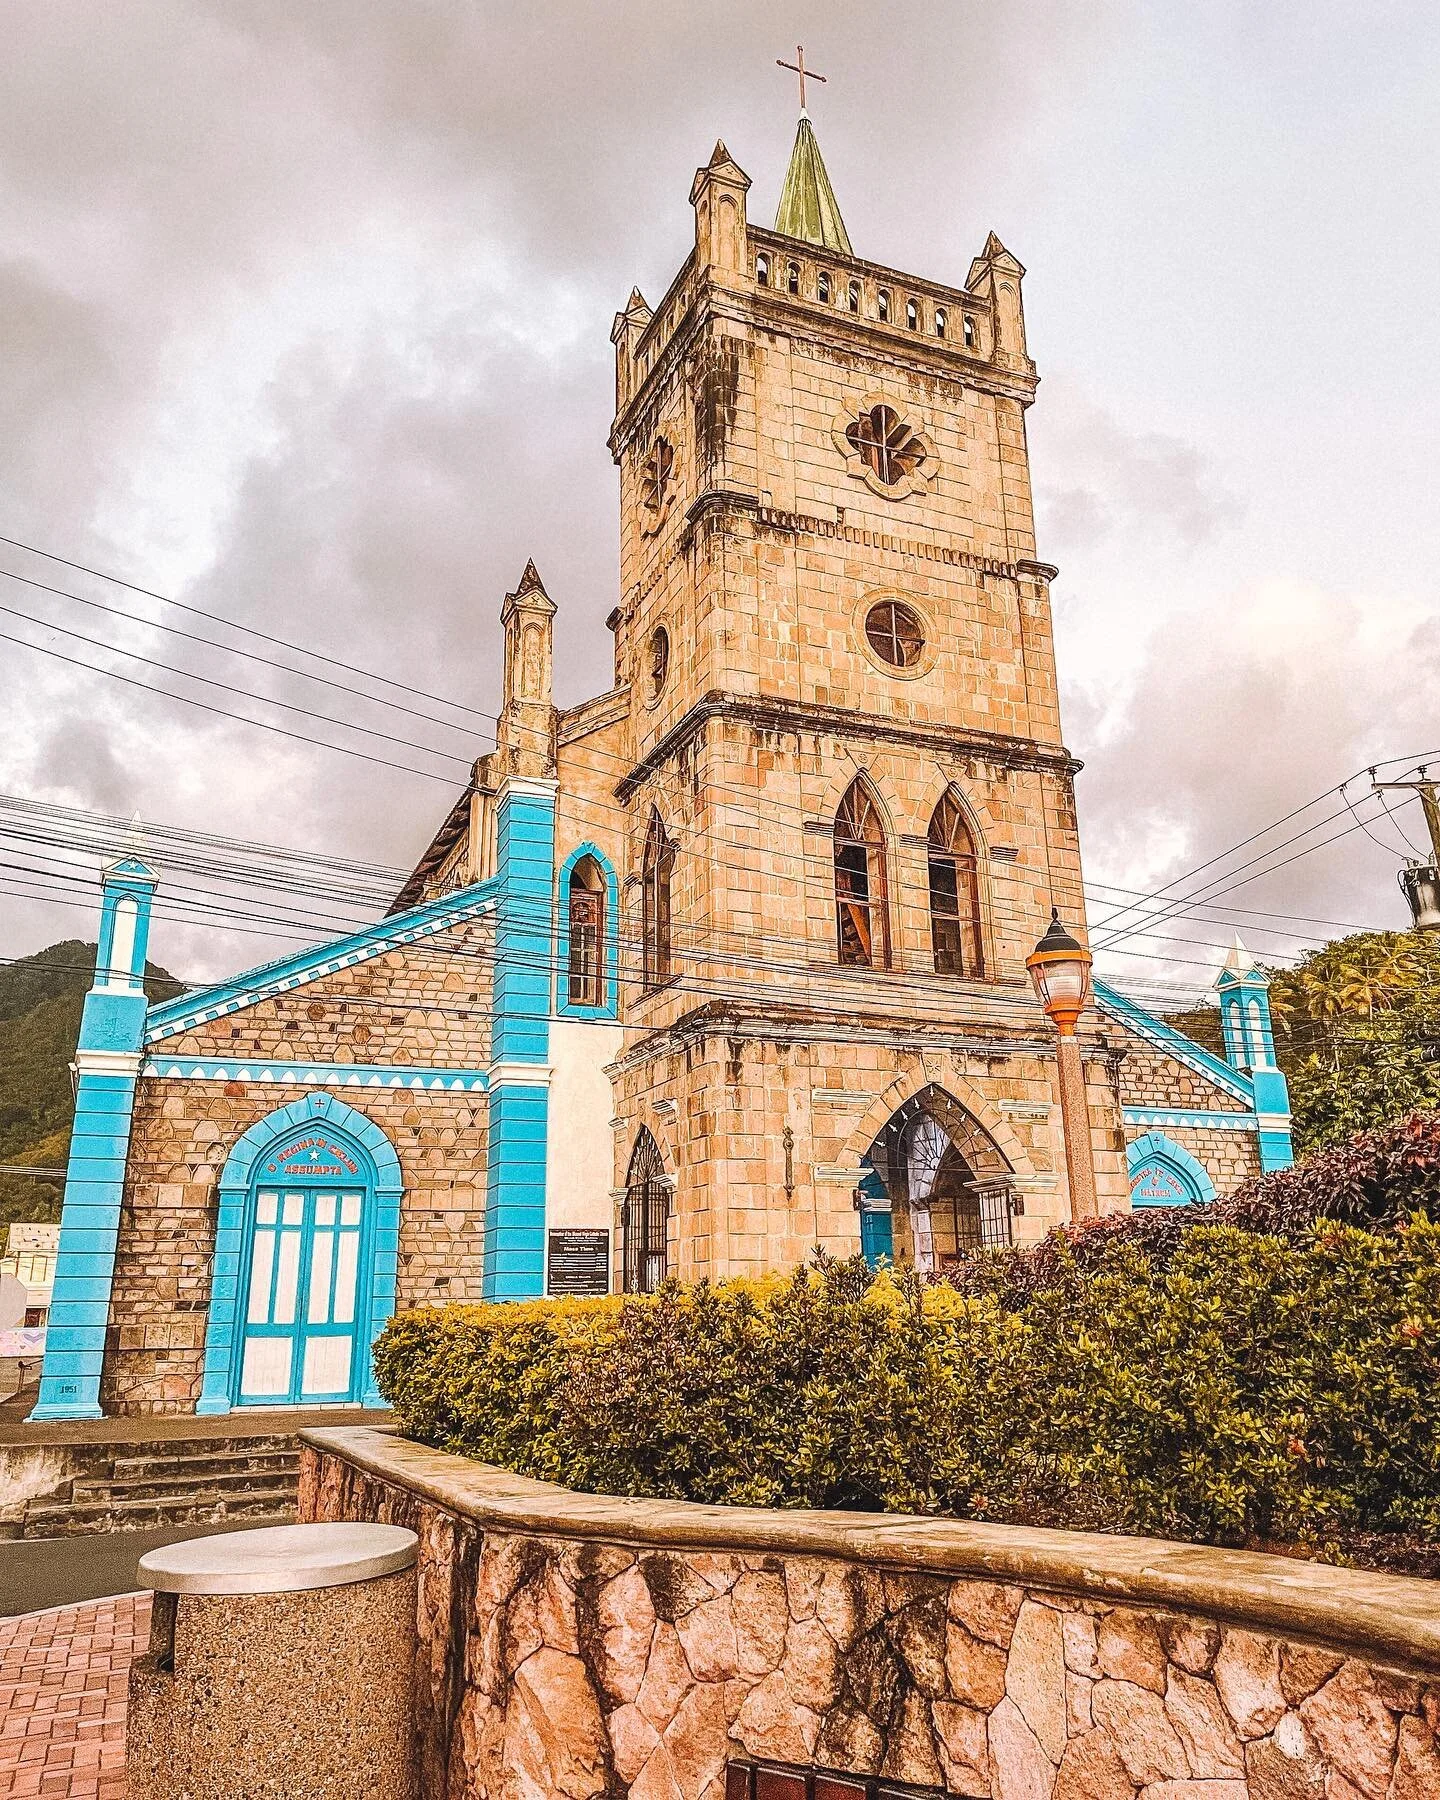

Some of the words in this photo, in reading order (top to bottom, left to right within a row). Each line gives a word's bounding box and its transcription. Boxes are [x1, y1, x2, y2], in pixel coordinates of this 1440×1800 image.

[268, 1164, 277, 1173] O
[278, 1138, 315, 1162] REGINA
[285, 1165, 342, 1175] ASSUMPTA
[60, 1386, 77, 1394] 1951
